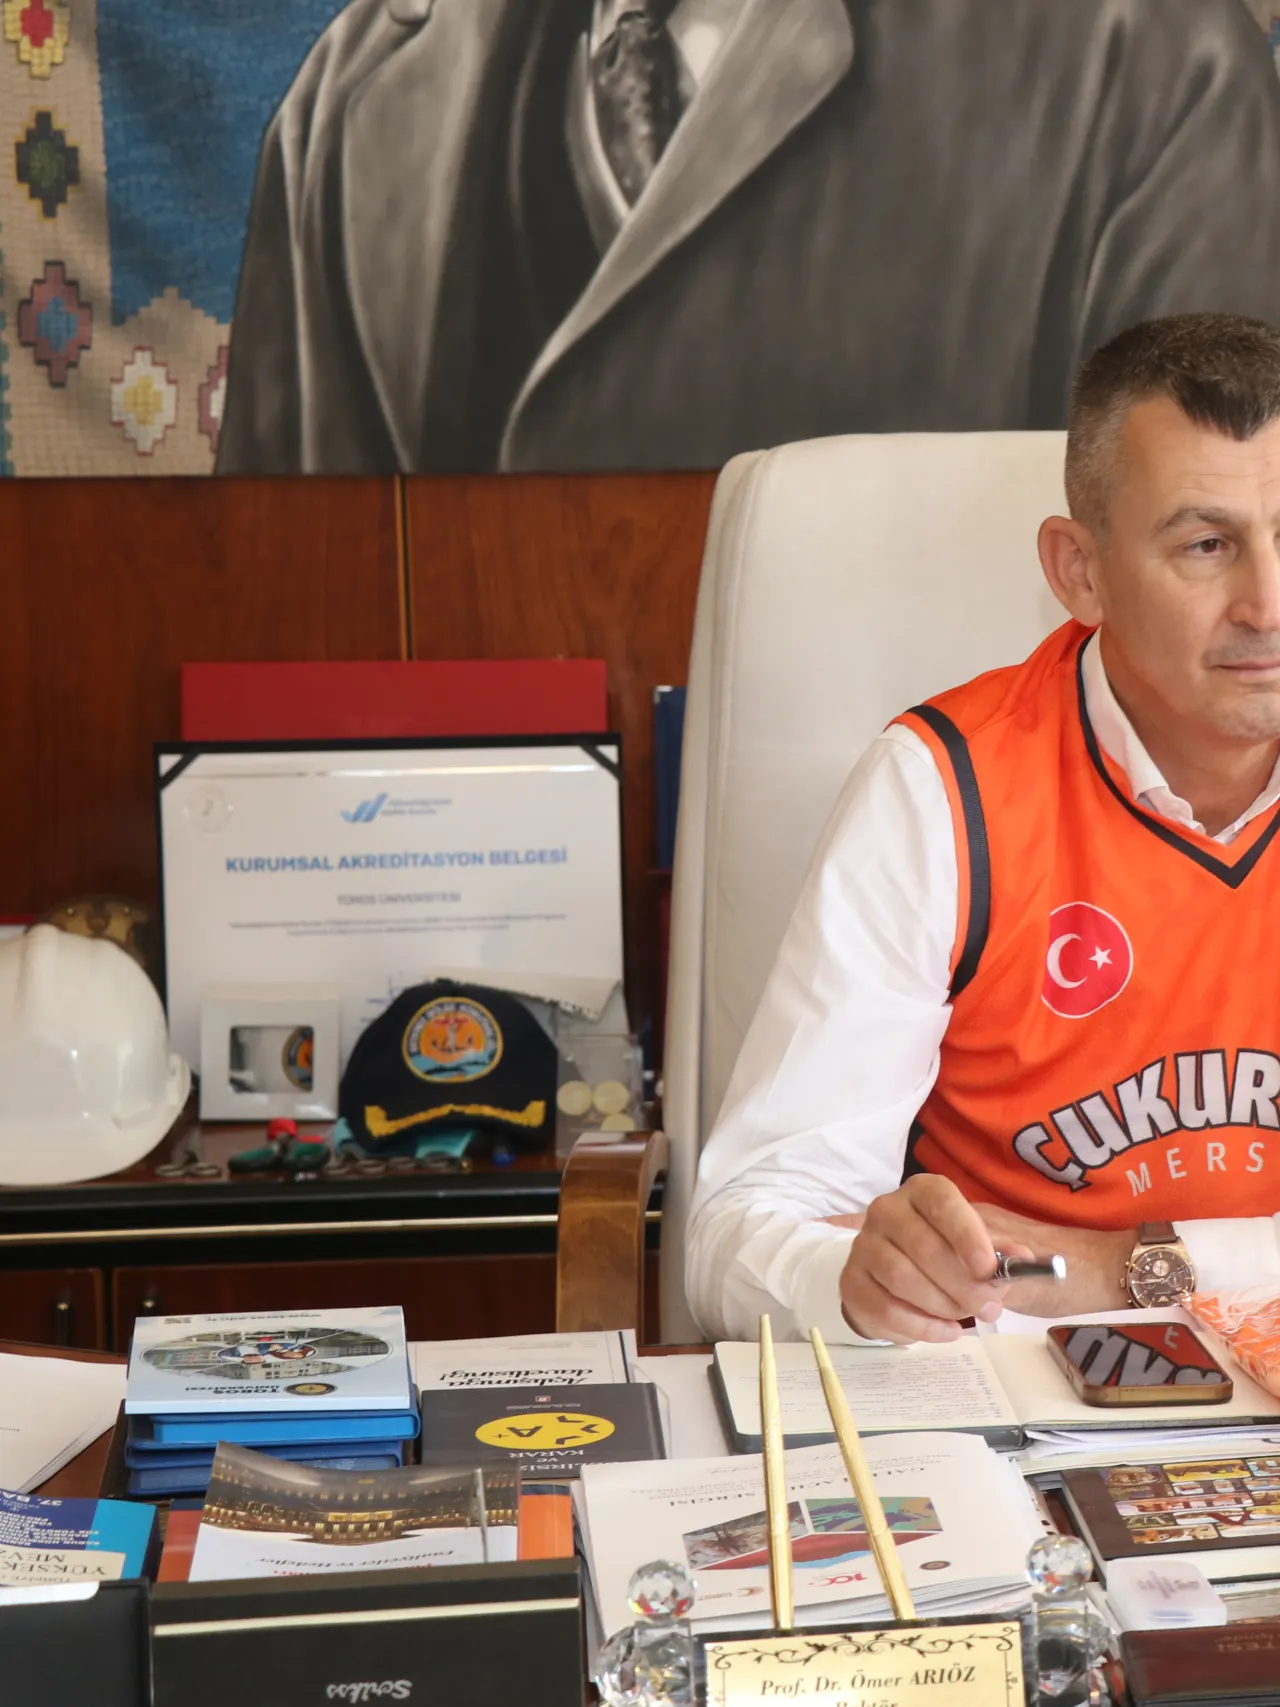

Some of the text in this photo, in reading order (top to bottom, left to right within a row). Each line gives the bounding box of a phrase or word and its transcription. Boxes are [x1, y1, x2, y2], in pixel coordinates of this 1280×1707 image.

[225, 844, 568, 873] KURUMSAL AKREDİTASYON BELGESİ
[509, 1449, 585, 1458] KARAR
[3, 1561, 106, 1577] YÜKSEK
[326, 1680, 414, 1704] Scrikss
[760, 1663, 976, 1697] Prof. Dr. Ömer ARIÖZ
